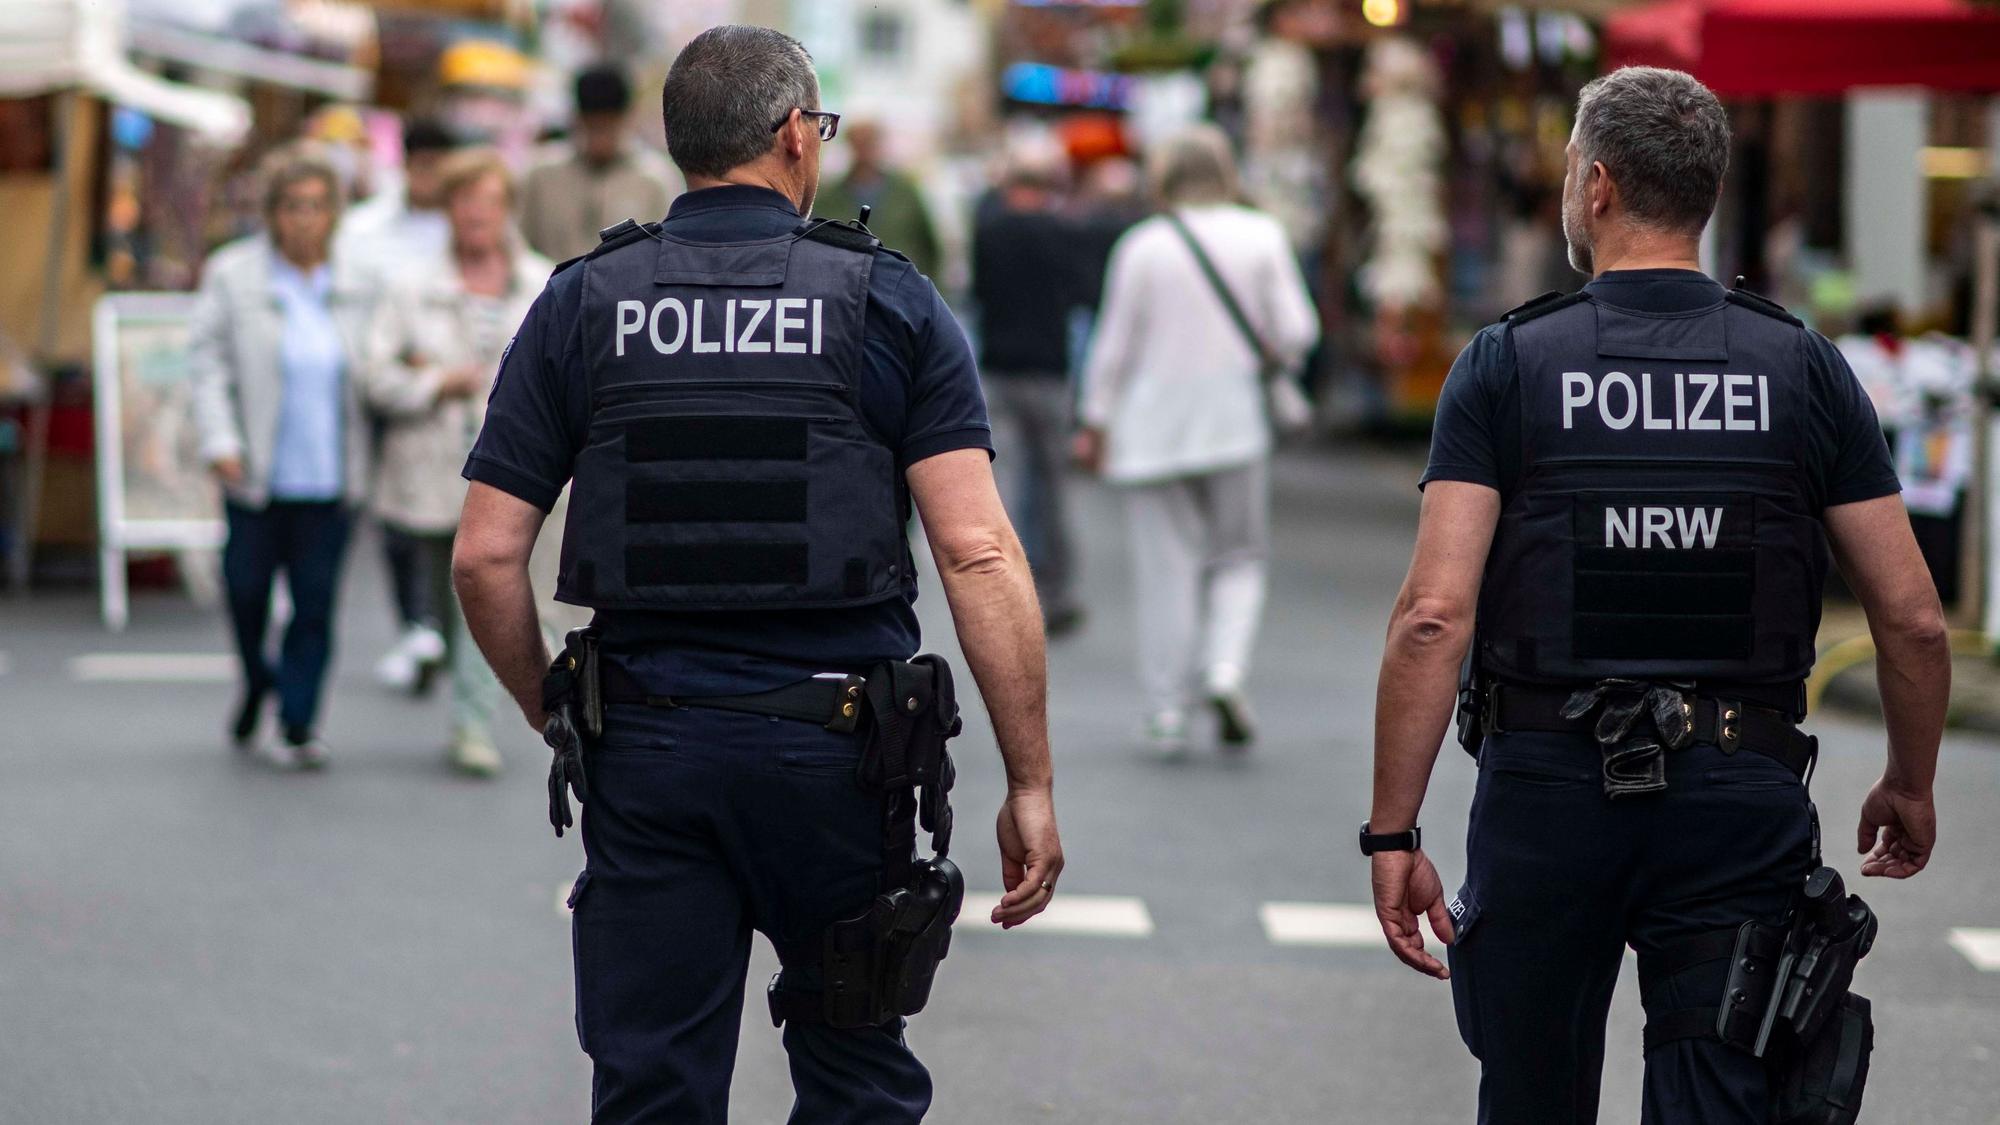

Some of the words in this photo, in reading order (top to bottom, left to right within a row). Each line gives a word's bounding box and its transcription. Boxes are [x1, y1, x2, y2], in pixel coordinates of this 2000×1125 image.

[617, 298, 822, 356] POLIZEI
[1562, 371, 1770, 431] POLIZEI
[1605, 506, 1723, 549] NRW
